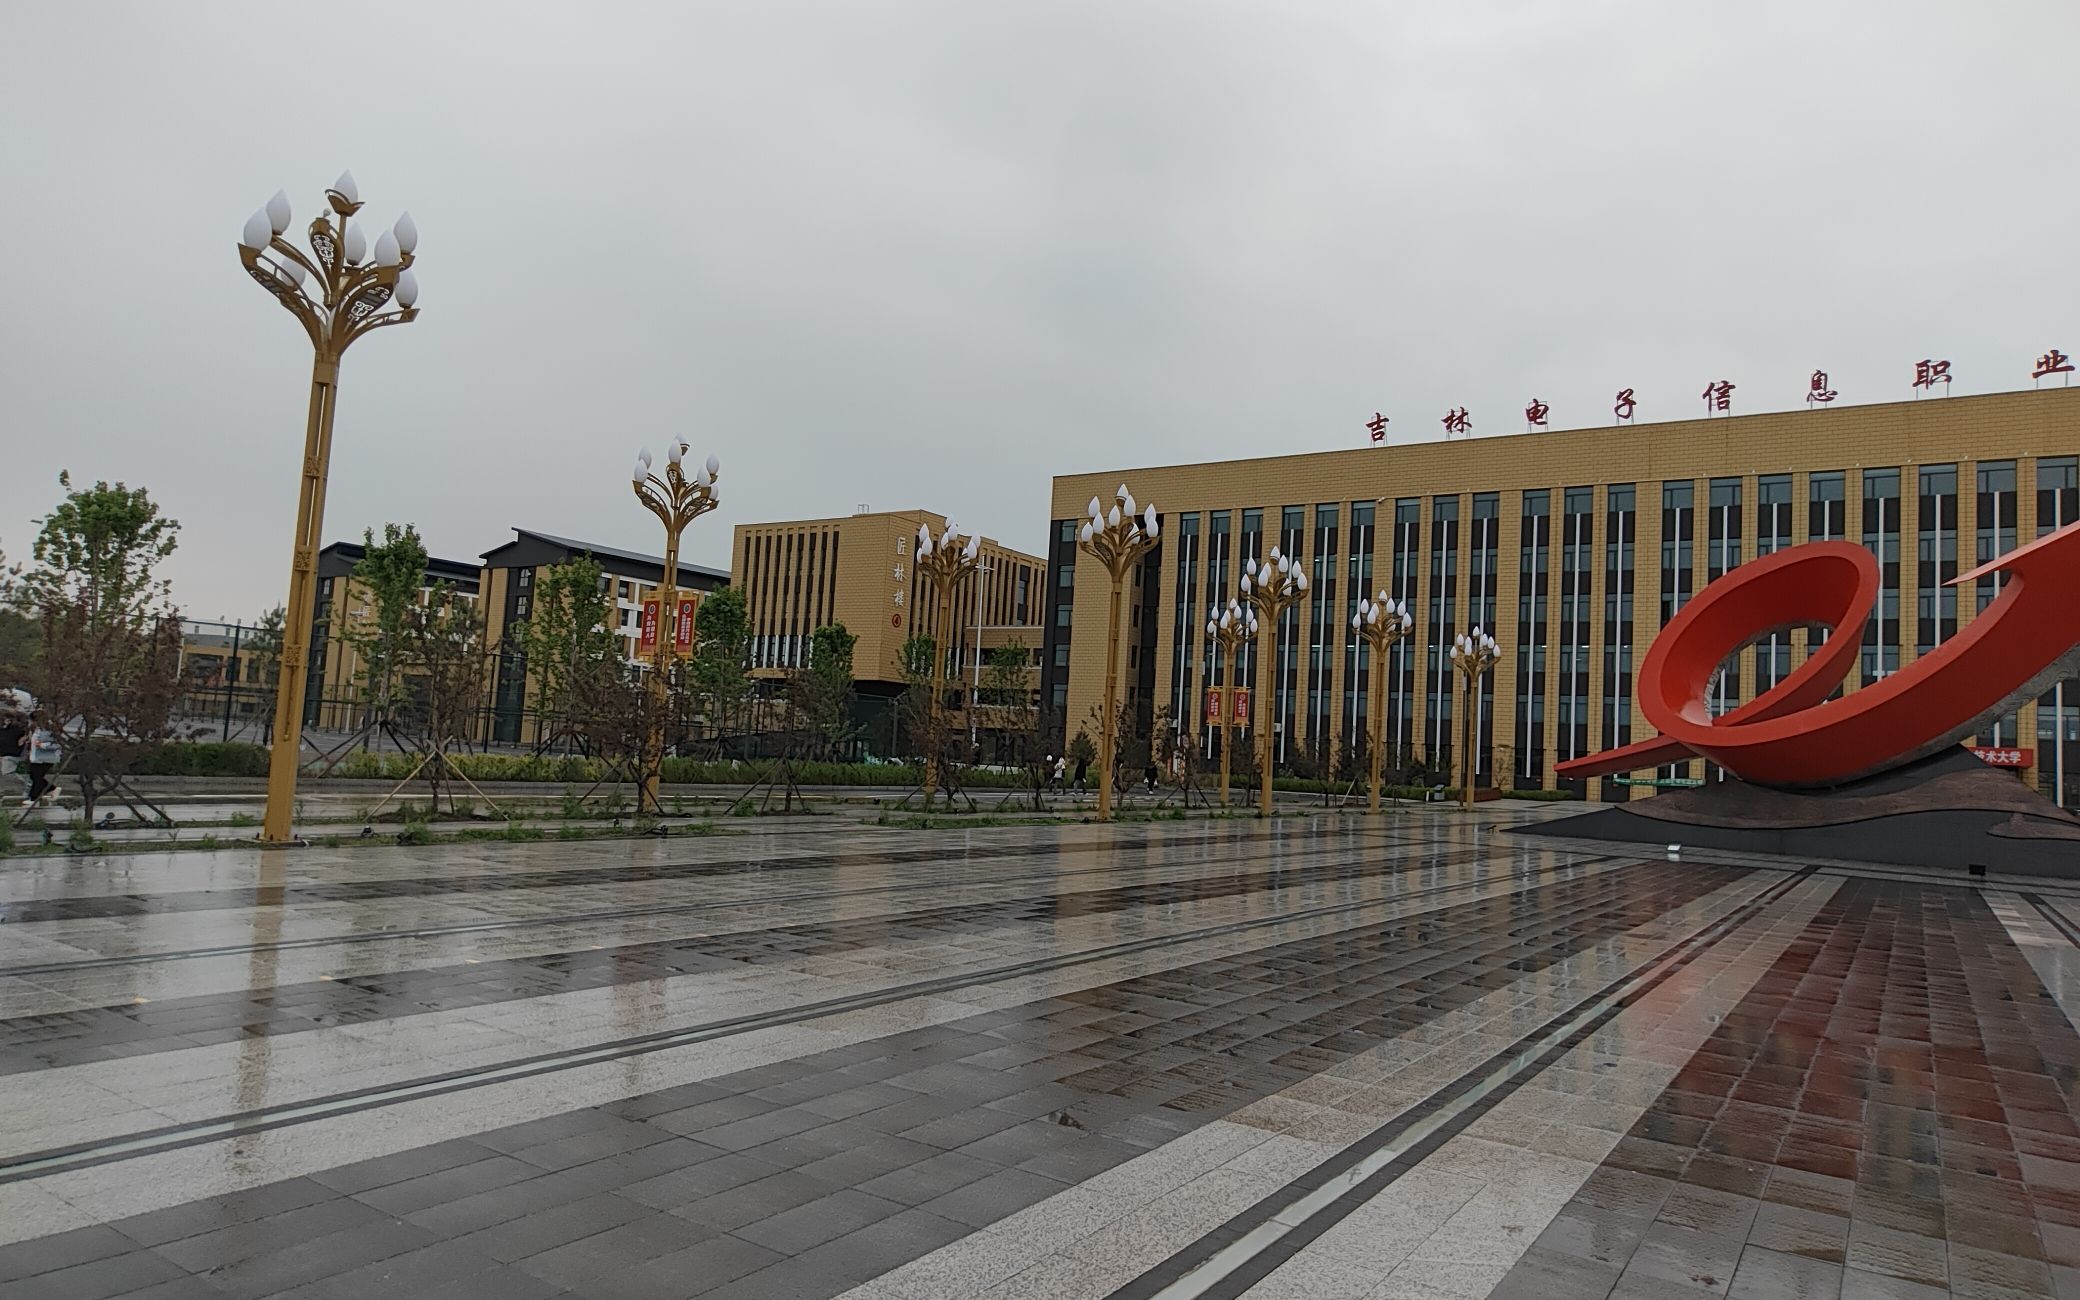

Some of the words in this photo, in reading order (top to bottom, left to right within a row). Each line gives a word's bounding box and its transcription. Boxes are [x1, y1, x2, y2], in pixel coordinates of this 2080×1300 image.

[1366, 350, 2075, 441] 吉林电子信息职业
